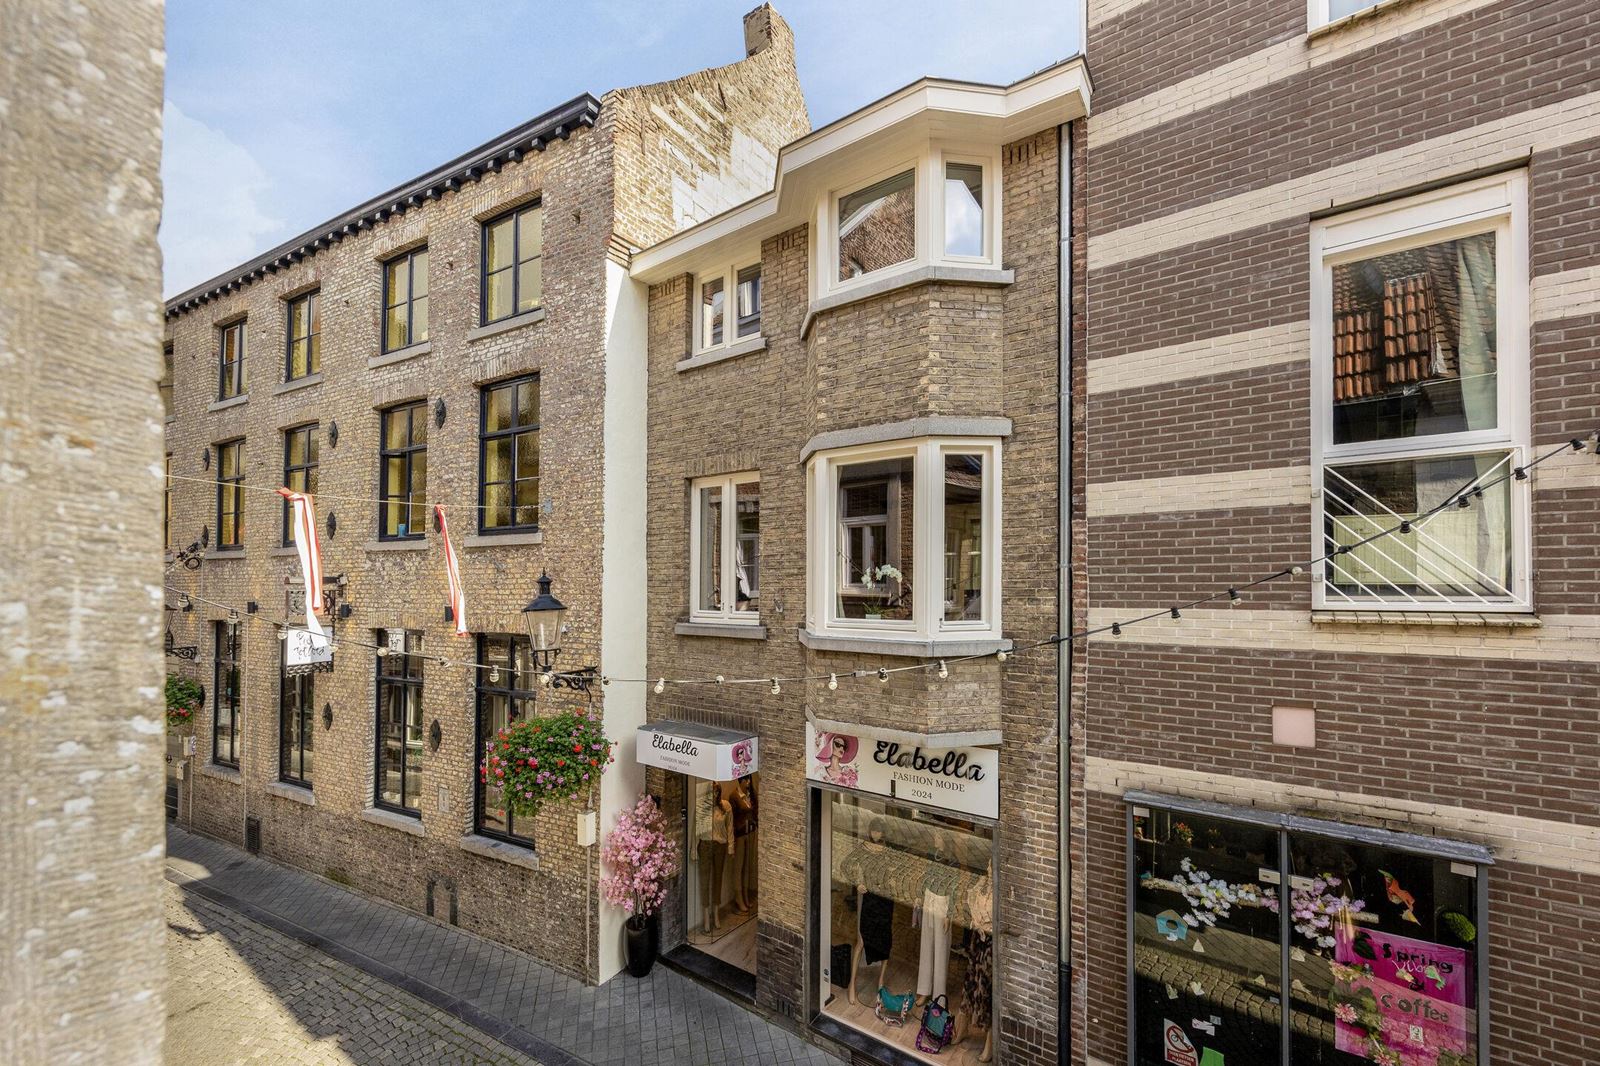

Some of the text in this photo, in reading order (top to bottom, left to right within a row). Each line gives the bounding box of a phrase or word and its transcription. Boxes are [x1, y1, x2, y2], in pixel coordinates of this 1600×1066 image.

[652, 734, 698, 757] Elabella
[873, 740, 985, 781] Elabella
[893, 771, 966, 793] FASHION MODE
[911, 788, 933, 800] 2024
[1382, 943, 1453, 973] Spring
[1381, 994, 1449, 1022] Coffee
